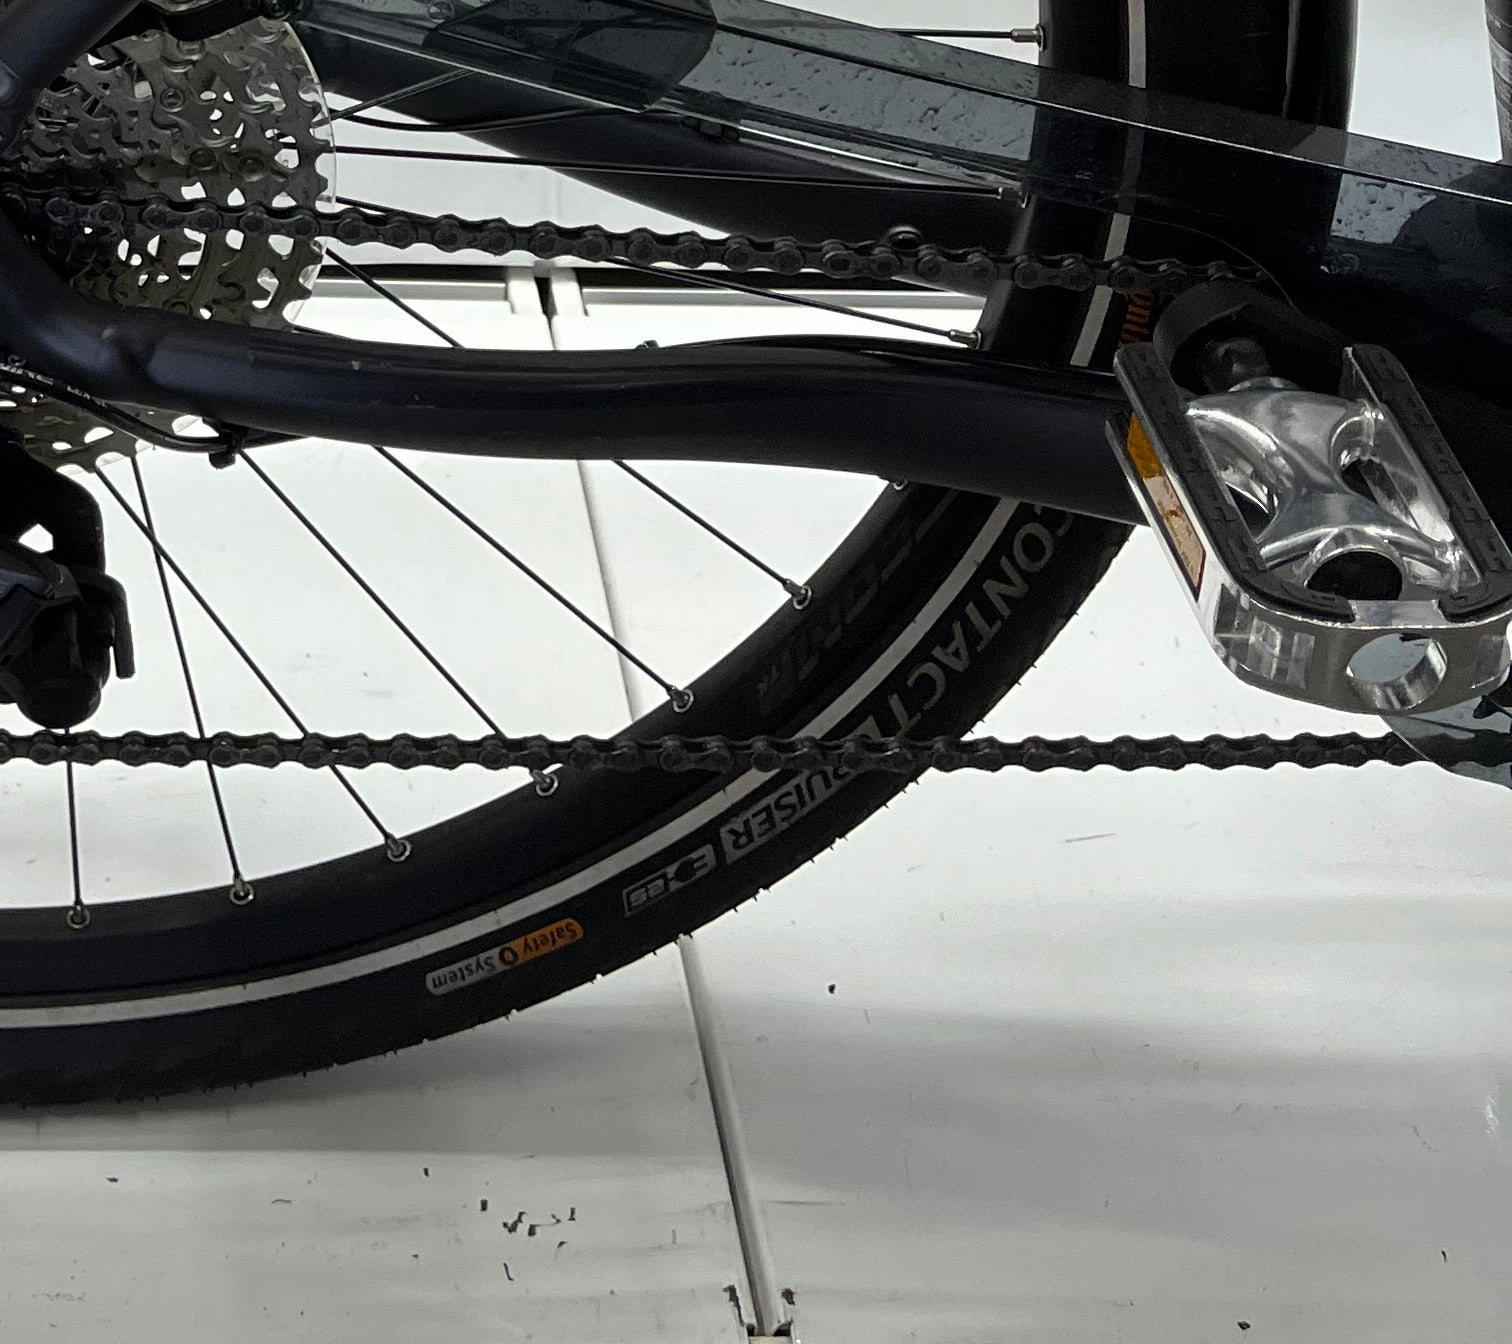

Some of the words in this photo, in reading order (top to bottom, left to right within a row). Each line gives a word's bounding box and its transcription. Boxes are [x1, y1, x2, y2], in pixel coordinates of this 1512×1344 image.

[725, 765, 852, 850] UISER
[522, 921, 578, 954] Safety
[431, 955, 497, 989] System
